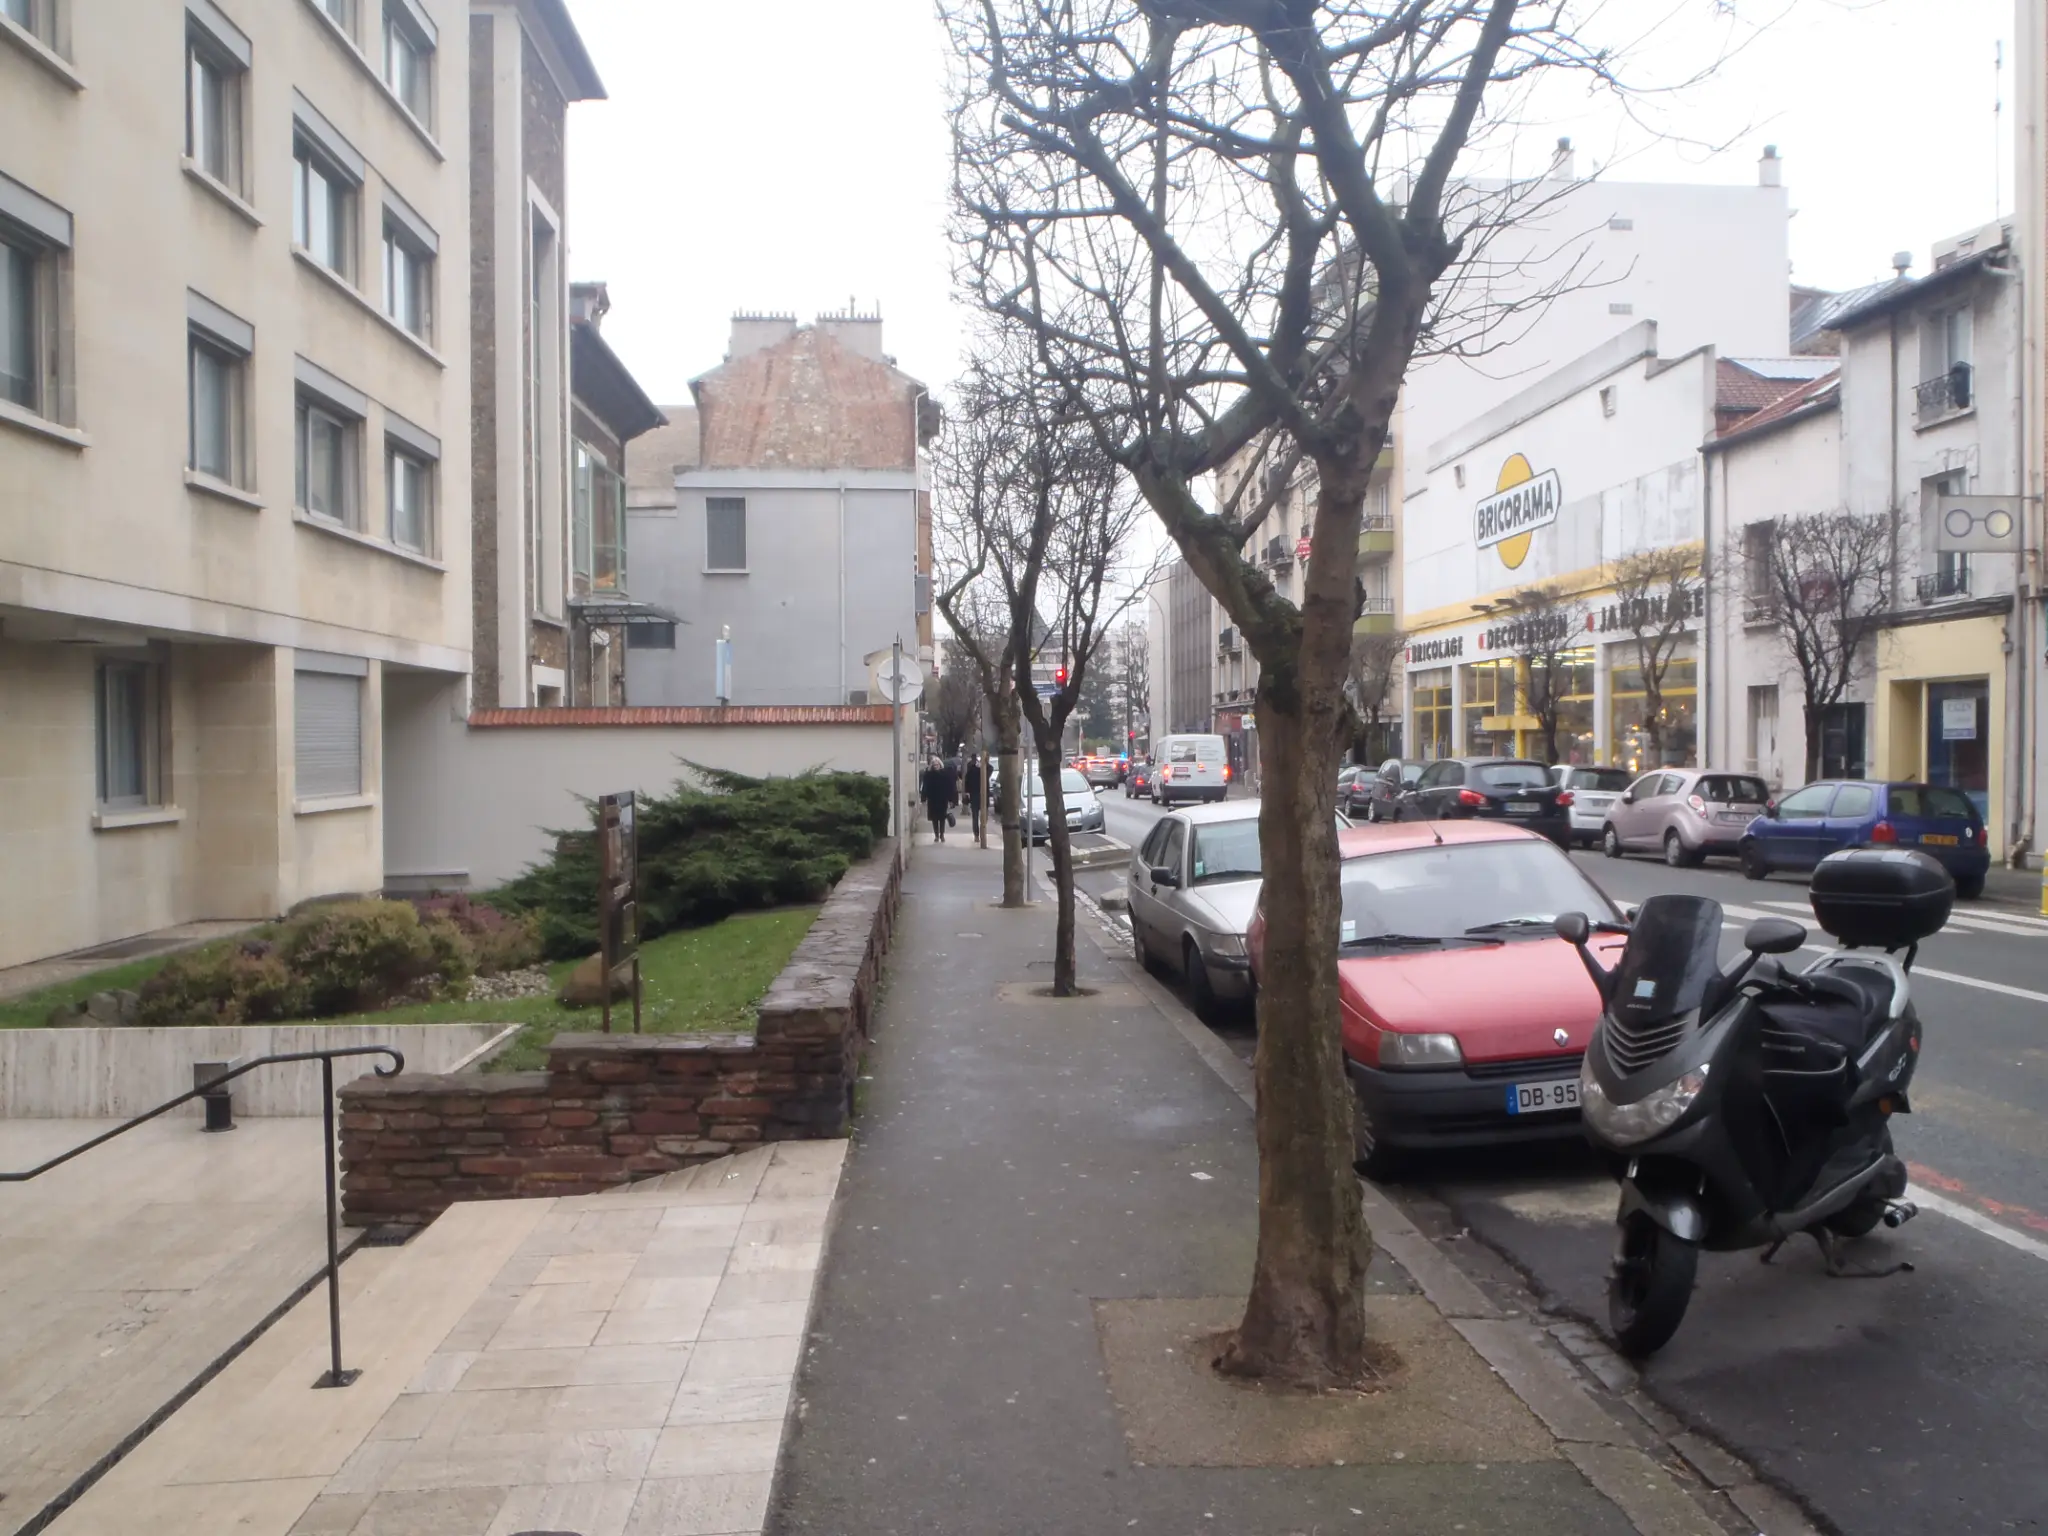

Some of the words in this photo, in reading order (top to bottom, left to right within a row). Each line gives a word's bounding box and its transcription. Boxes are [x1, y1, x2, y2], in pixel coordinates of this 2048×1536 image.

[1478, 479, 1554, 541] BRICORAMA
[1411, 635, 1463, 663] BRICOLAGE
[1600, 586, 1704, 633] JARDINGE
[1519, 1083, 1580, 1108] DB-95
